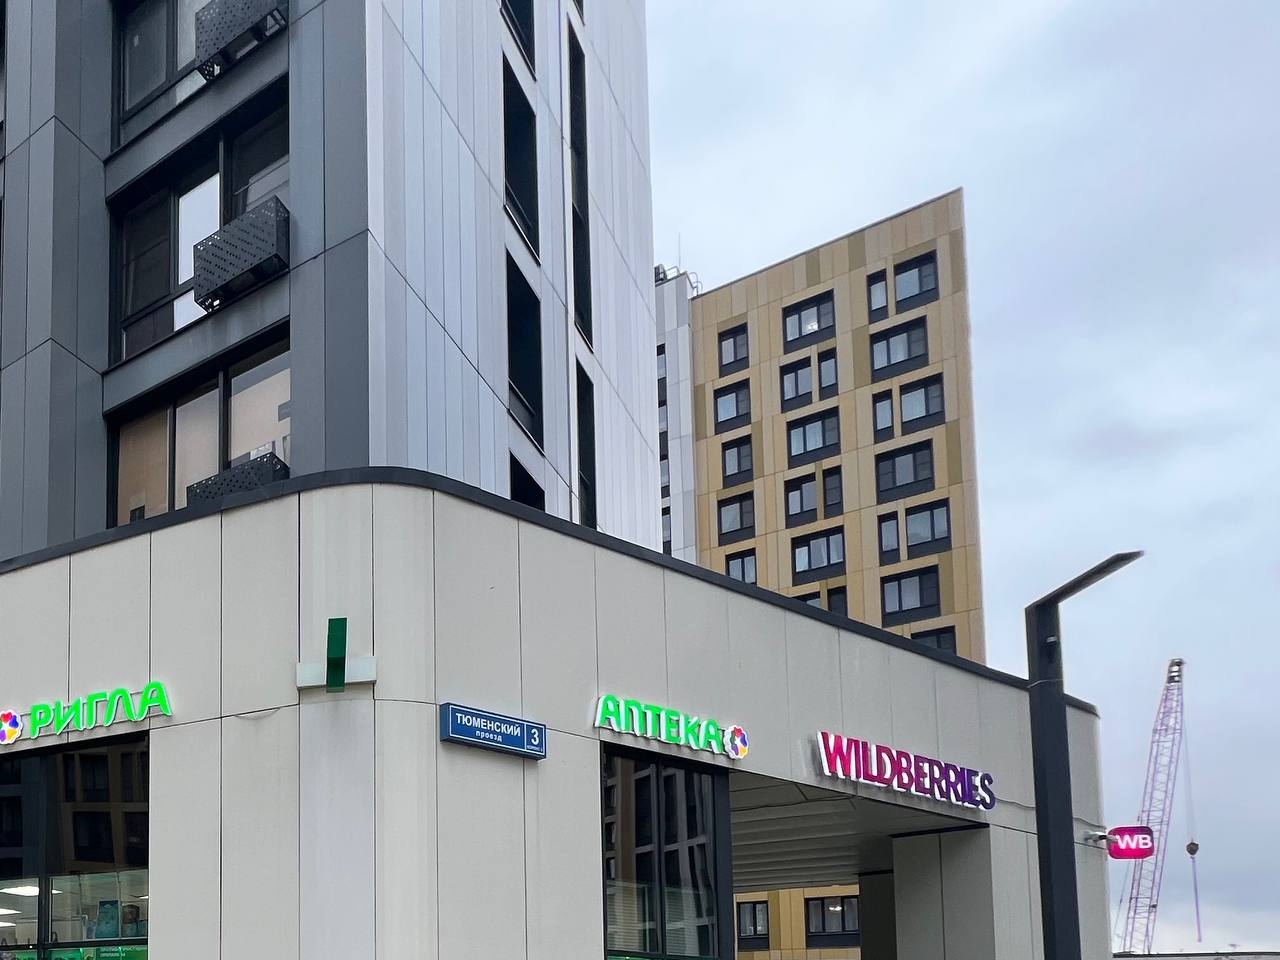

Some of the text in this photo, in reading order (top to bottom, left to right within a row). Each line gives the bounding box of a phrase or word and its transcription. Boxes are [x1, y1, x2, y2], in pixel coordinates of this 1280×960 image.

[30, 681, 172, 738] РИГЛА
[455, 712, 540, 746] ТЮМЕНСКИЙ 3
[595, 694, 726, 754] АПТЕКА
[818, 730, 996, 811] WILDBERRIES
[1116, 834, 1152, 849] WB
